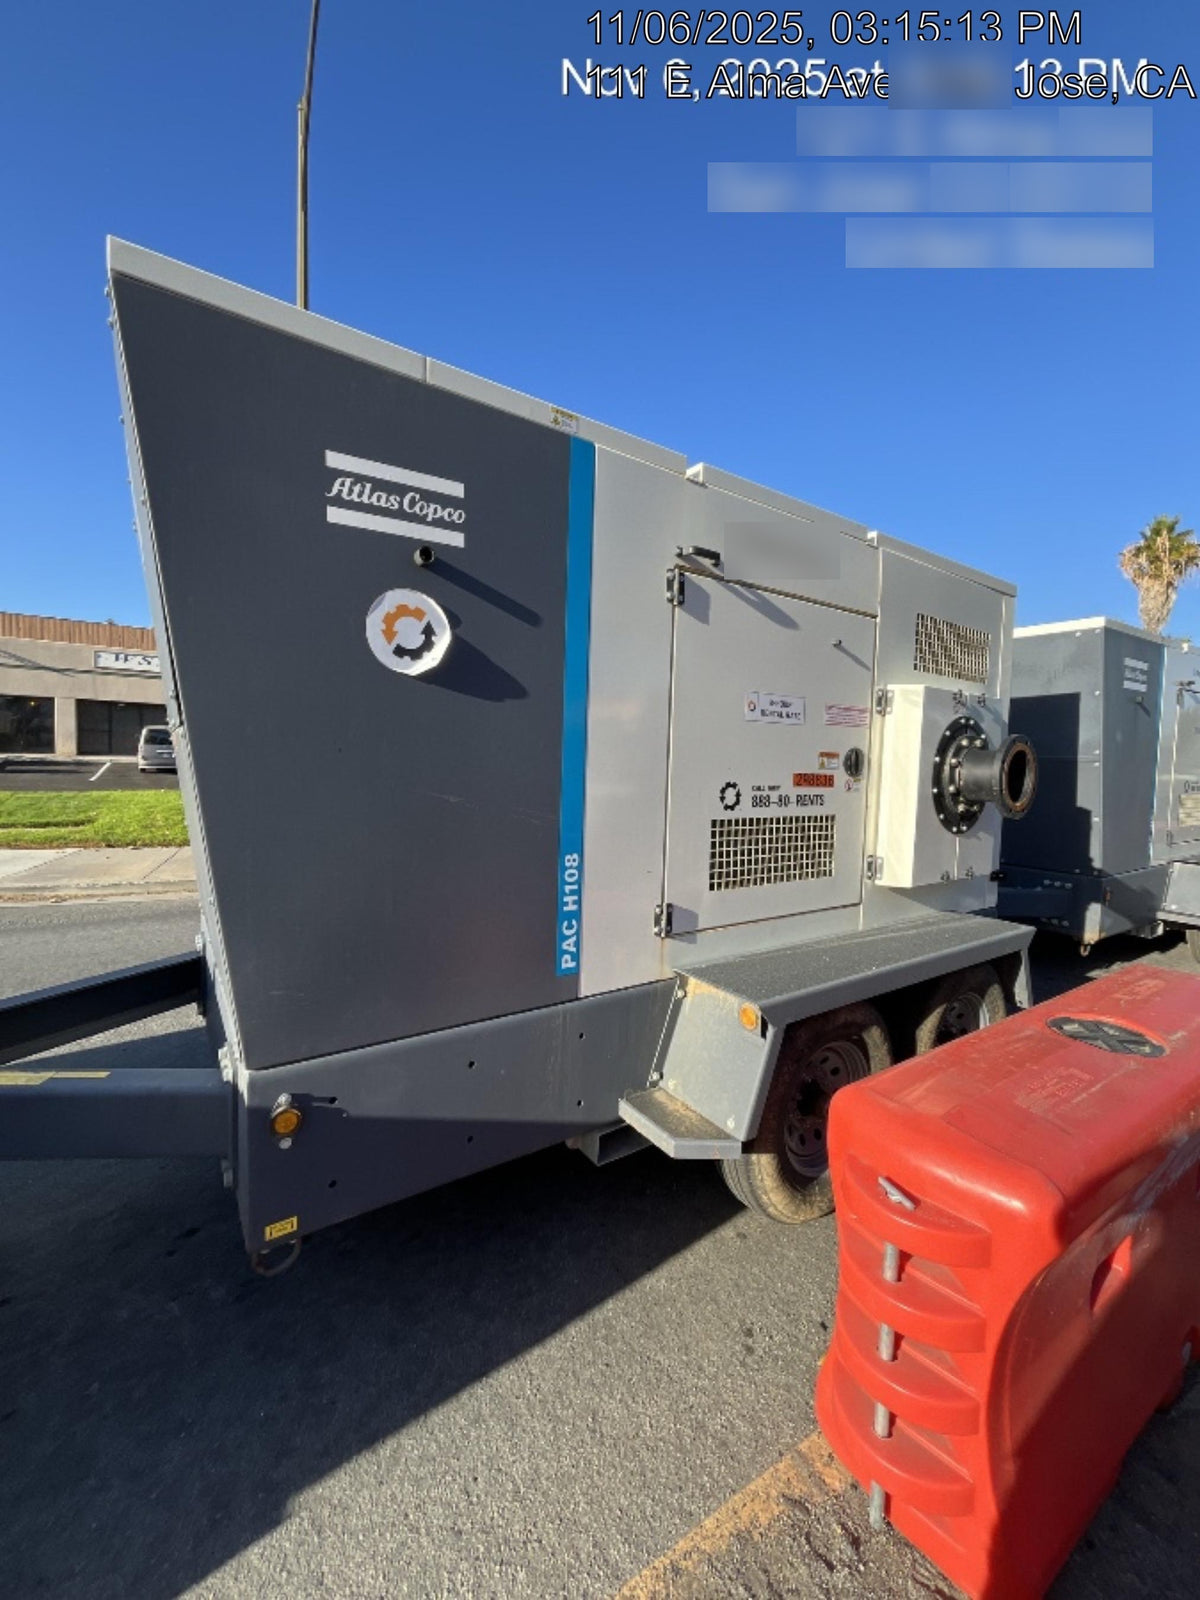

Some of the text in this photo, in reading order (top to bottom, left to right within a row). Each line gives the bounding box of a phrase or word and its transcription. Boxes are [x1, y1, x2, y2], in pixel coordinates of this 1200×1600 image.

[325, 477, 466, 524] Atlas Copco
[561, 853, 579, 970] PAC H108
